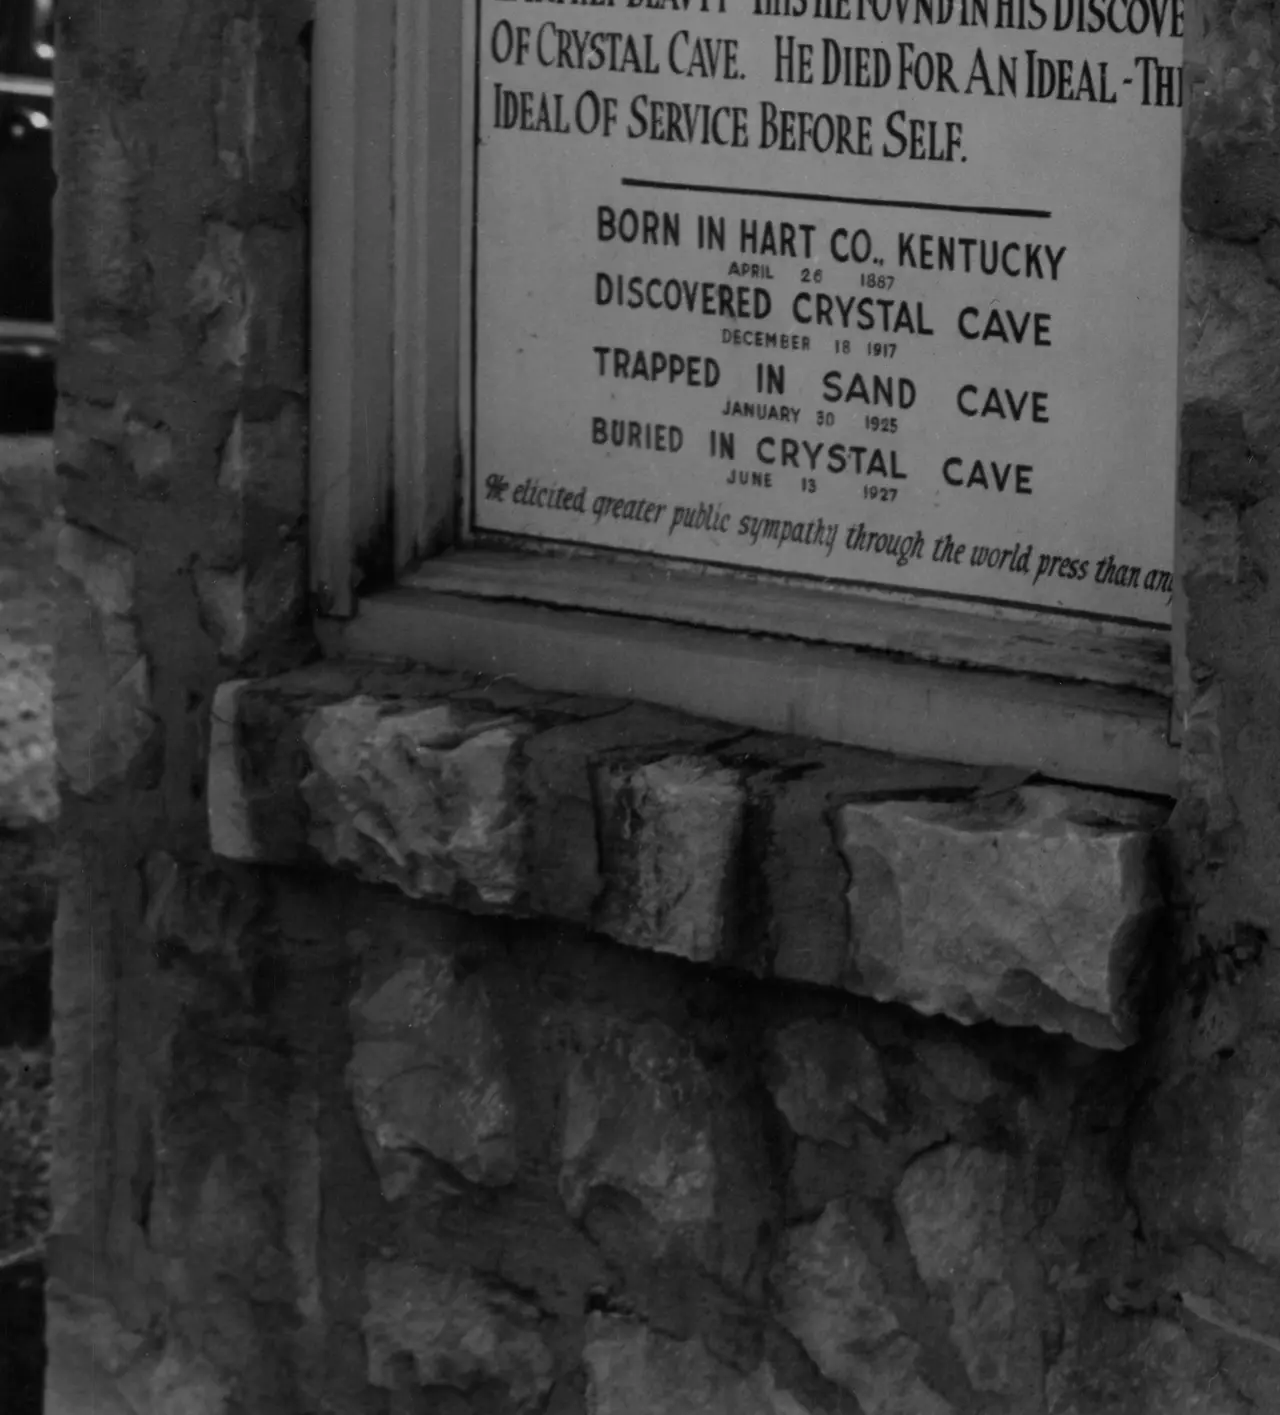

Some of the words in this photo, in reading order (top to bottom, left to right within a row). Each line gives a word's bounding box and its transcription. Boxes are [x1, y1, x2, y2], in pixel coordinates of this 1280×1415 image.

[491, 20, 530, 65] OF
[537, 22, 659, 73] CRYSTAL
[669, 31, 745, 79] CAVE.
[775, 35, 813, 83] HE
[822, 38, 890, 87] DIED
[897, 43, 959, 93] FOR
[965, 48, 1017, 97] AN
[1025, 50, 1116, 102] IDEAL
[494, 83, 570, 133] IDEAL
[576, 90, 617, 136] OF
[627, 95, 748, 147] SERVICE
[759, 102, 872, 156] BEFORE
[883, 110, 966, 162] SELF.
[598, 206, 679, 246] BORN
[699, 216, 724, 251] IN
[741, 220, 816, 258] HART
[899, 234, 1066, 280] KENTUCKY
[729, 262, 773, 278] APRIL
[801, 269, 822, 283] 26
[596, 273, 771, 320] DISCOVERED
[793, 292, 933, 335] CRYSTAL
[959, 307, 1051, 346] CAVE
[723, 329, 809, 350] DECEMBER
[836, 341, 850, 353] 18
[868, 343, 896, 357] 1917
[593, 347, 720, 387] TRAPPED
[757, 364, 784, 394] IN
[823, 371, 915, 409] SAND
[958, 385, 1049, 423] CAVE
[723, 401, 800, 423] JANUARY
[817, 411, 834, 426] 30
[866, 416, 897, 433] 1925
[593, 418, 682, 452] BURIED
[711, 431, 734, 459] IN
[756, 437, 907, 482] CRYSTAL
[943, 458, 1032, 494] CAVE
[727, 470, 771, 487] JUNE
[802, 478, 816, 492] 13
[865, 486, 897, 501] 1927
[513, 480, 586, 512] elicited
[593, 497, 666, 523] greater
[669, 504, 730, 535] public
[738, 516, 838, 556] sympathy
[846, 523, 924, 566] through
[933, 536, 965, 564] the
[971, 543, 1028, 574] world
[1034, 555, 1089, 585] press
[1095, 558, 1140, 588] than
